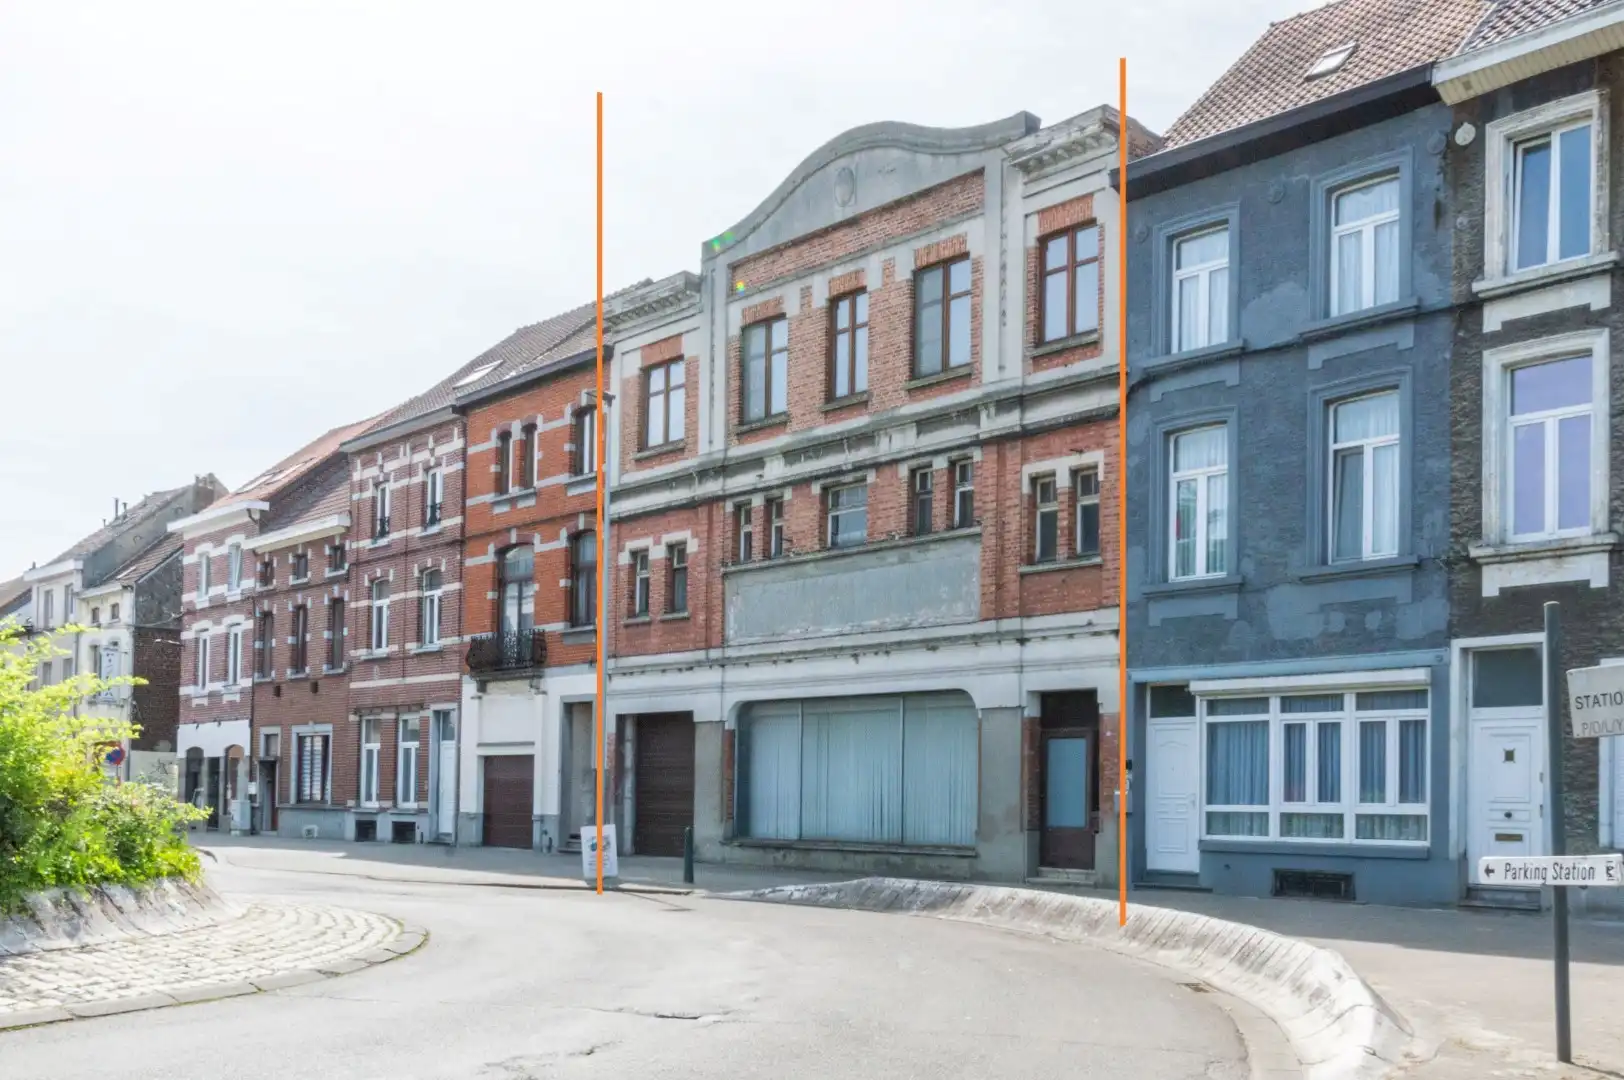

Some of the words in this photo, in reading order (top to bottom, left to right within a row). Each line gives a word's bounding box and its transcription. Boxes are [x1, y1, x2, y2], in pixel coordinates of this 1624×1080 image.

[1575, 691, 1624, 710] STATIO
[1504, 862, 1548, 885] Parking
[1552, 862, 1595, 881] Station
